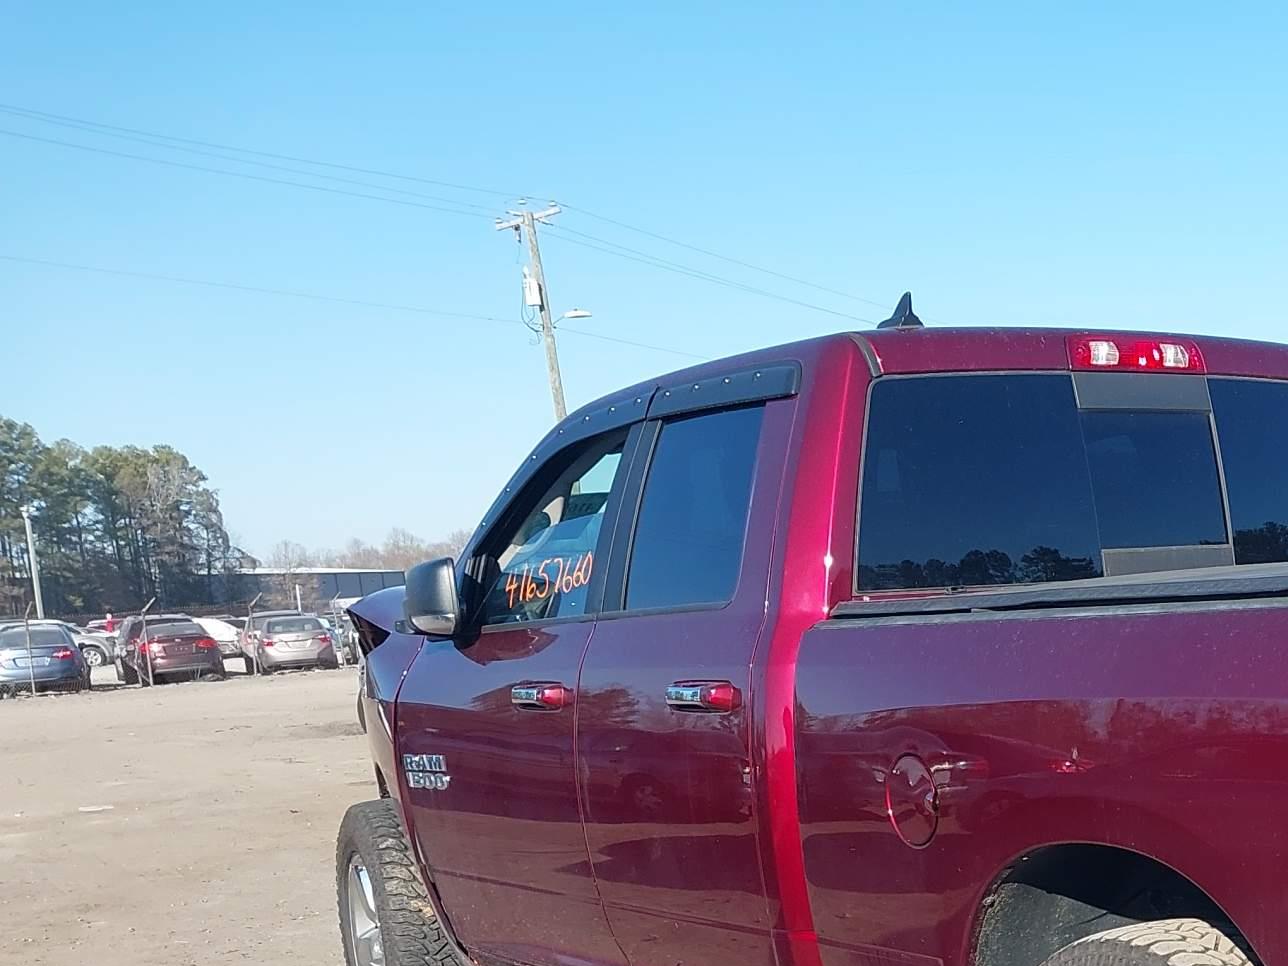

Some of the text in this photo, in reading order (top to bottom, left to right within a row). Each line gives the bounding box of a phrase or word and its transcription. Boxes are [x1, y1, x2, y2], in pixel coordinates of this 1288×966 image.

[505, 551, 593, 609] 41657660
[403, 754, 447, 771] RAM
[406, 771, 450, 790] 1500
